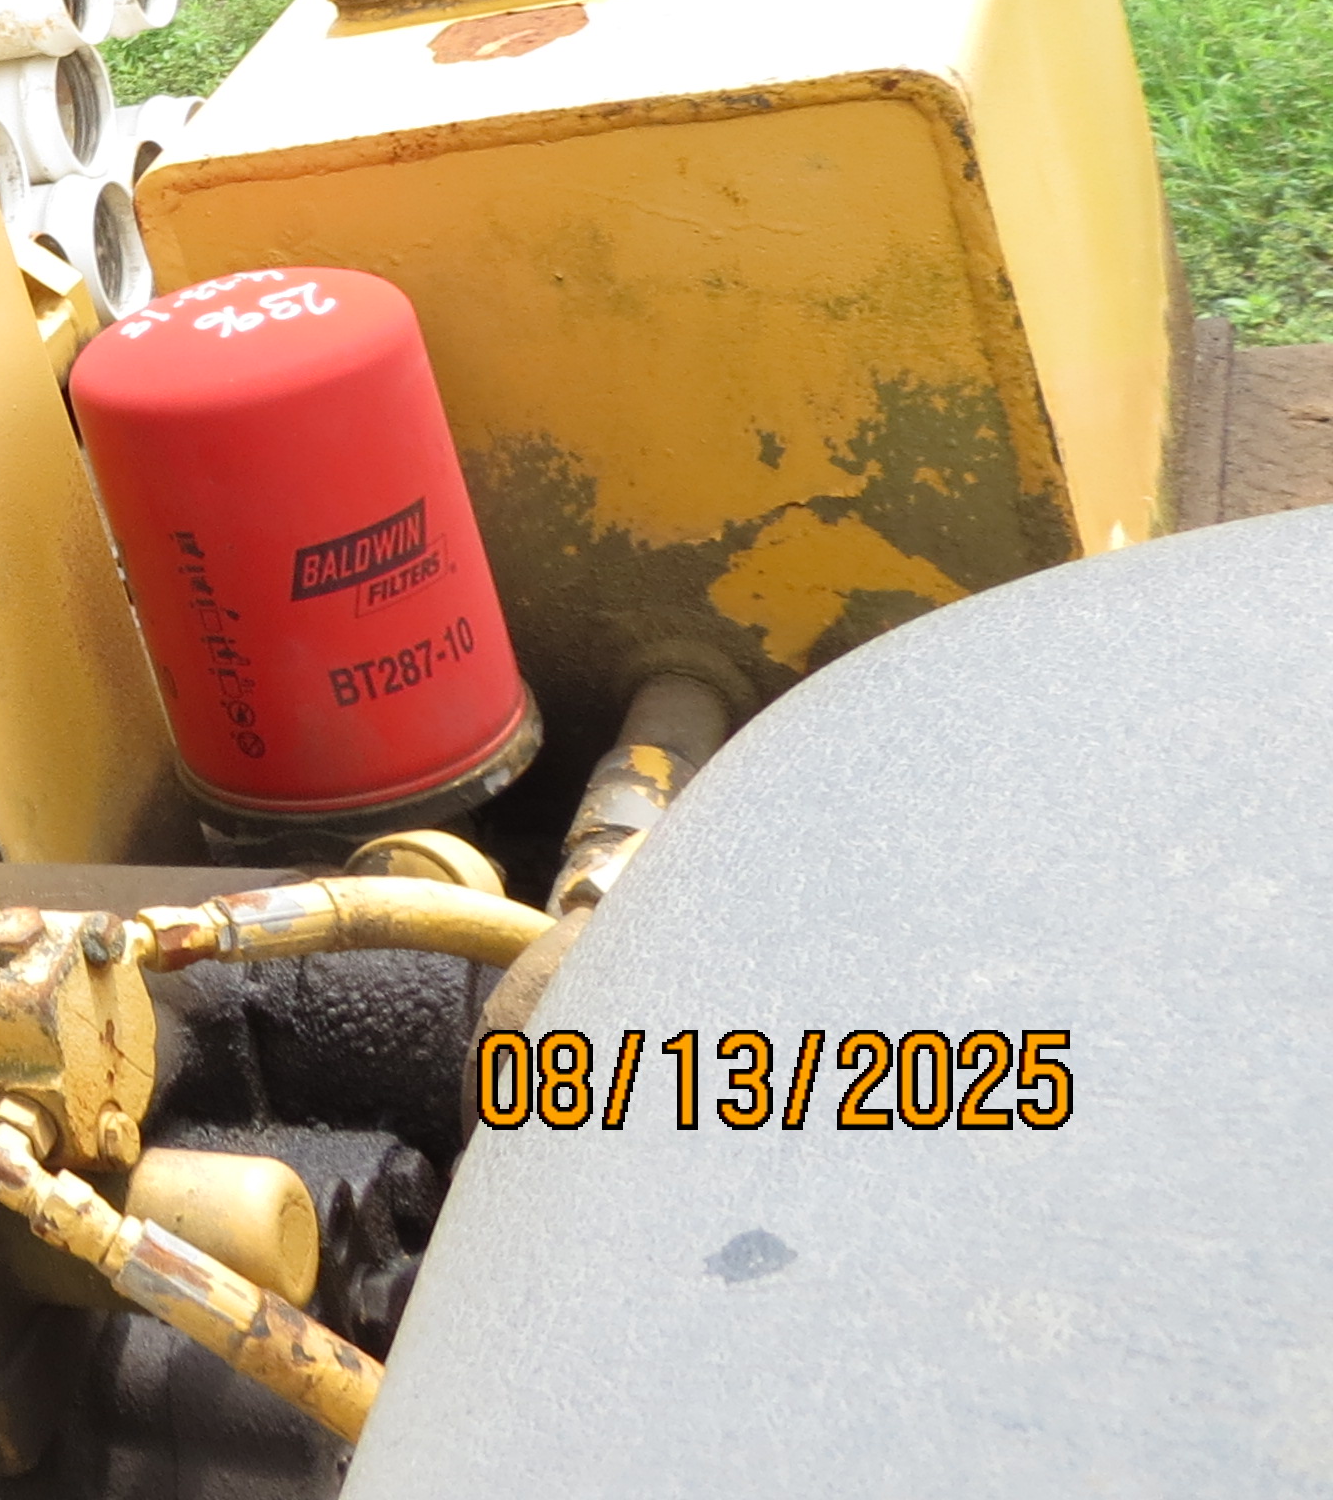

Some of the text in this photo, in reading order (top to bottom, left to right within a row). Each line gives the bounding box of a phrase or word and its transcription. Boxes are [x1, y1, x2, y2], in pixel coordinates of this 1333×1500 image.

[301, 512, 420, 589] BALDWIN
[368, 552, 440, 606] FILTERS
[329, 616, 473, 706] BT287-10
